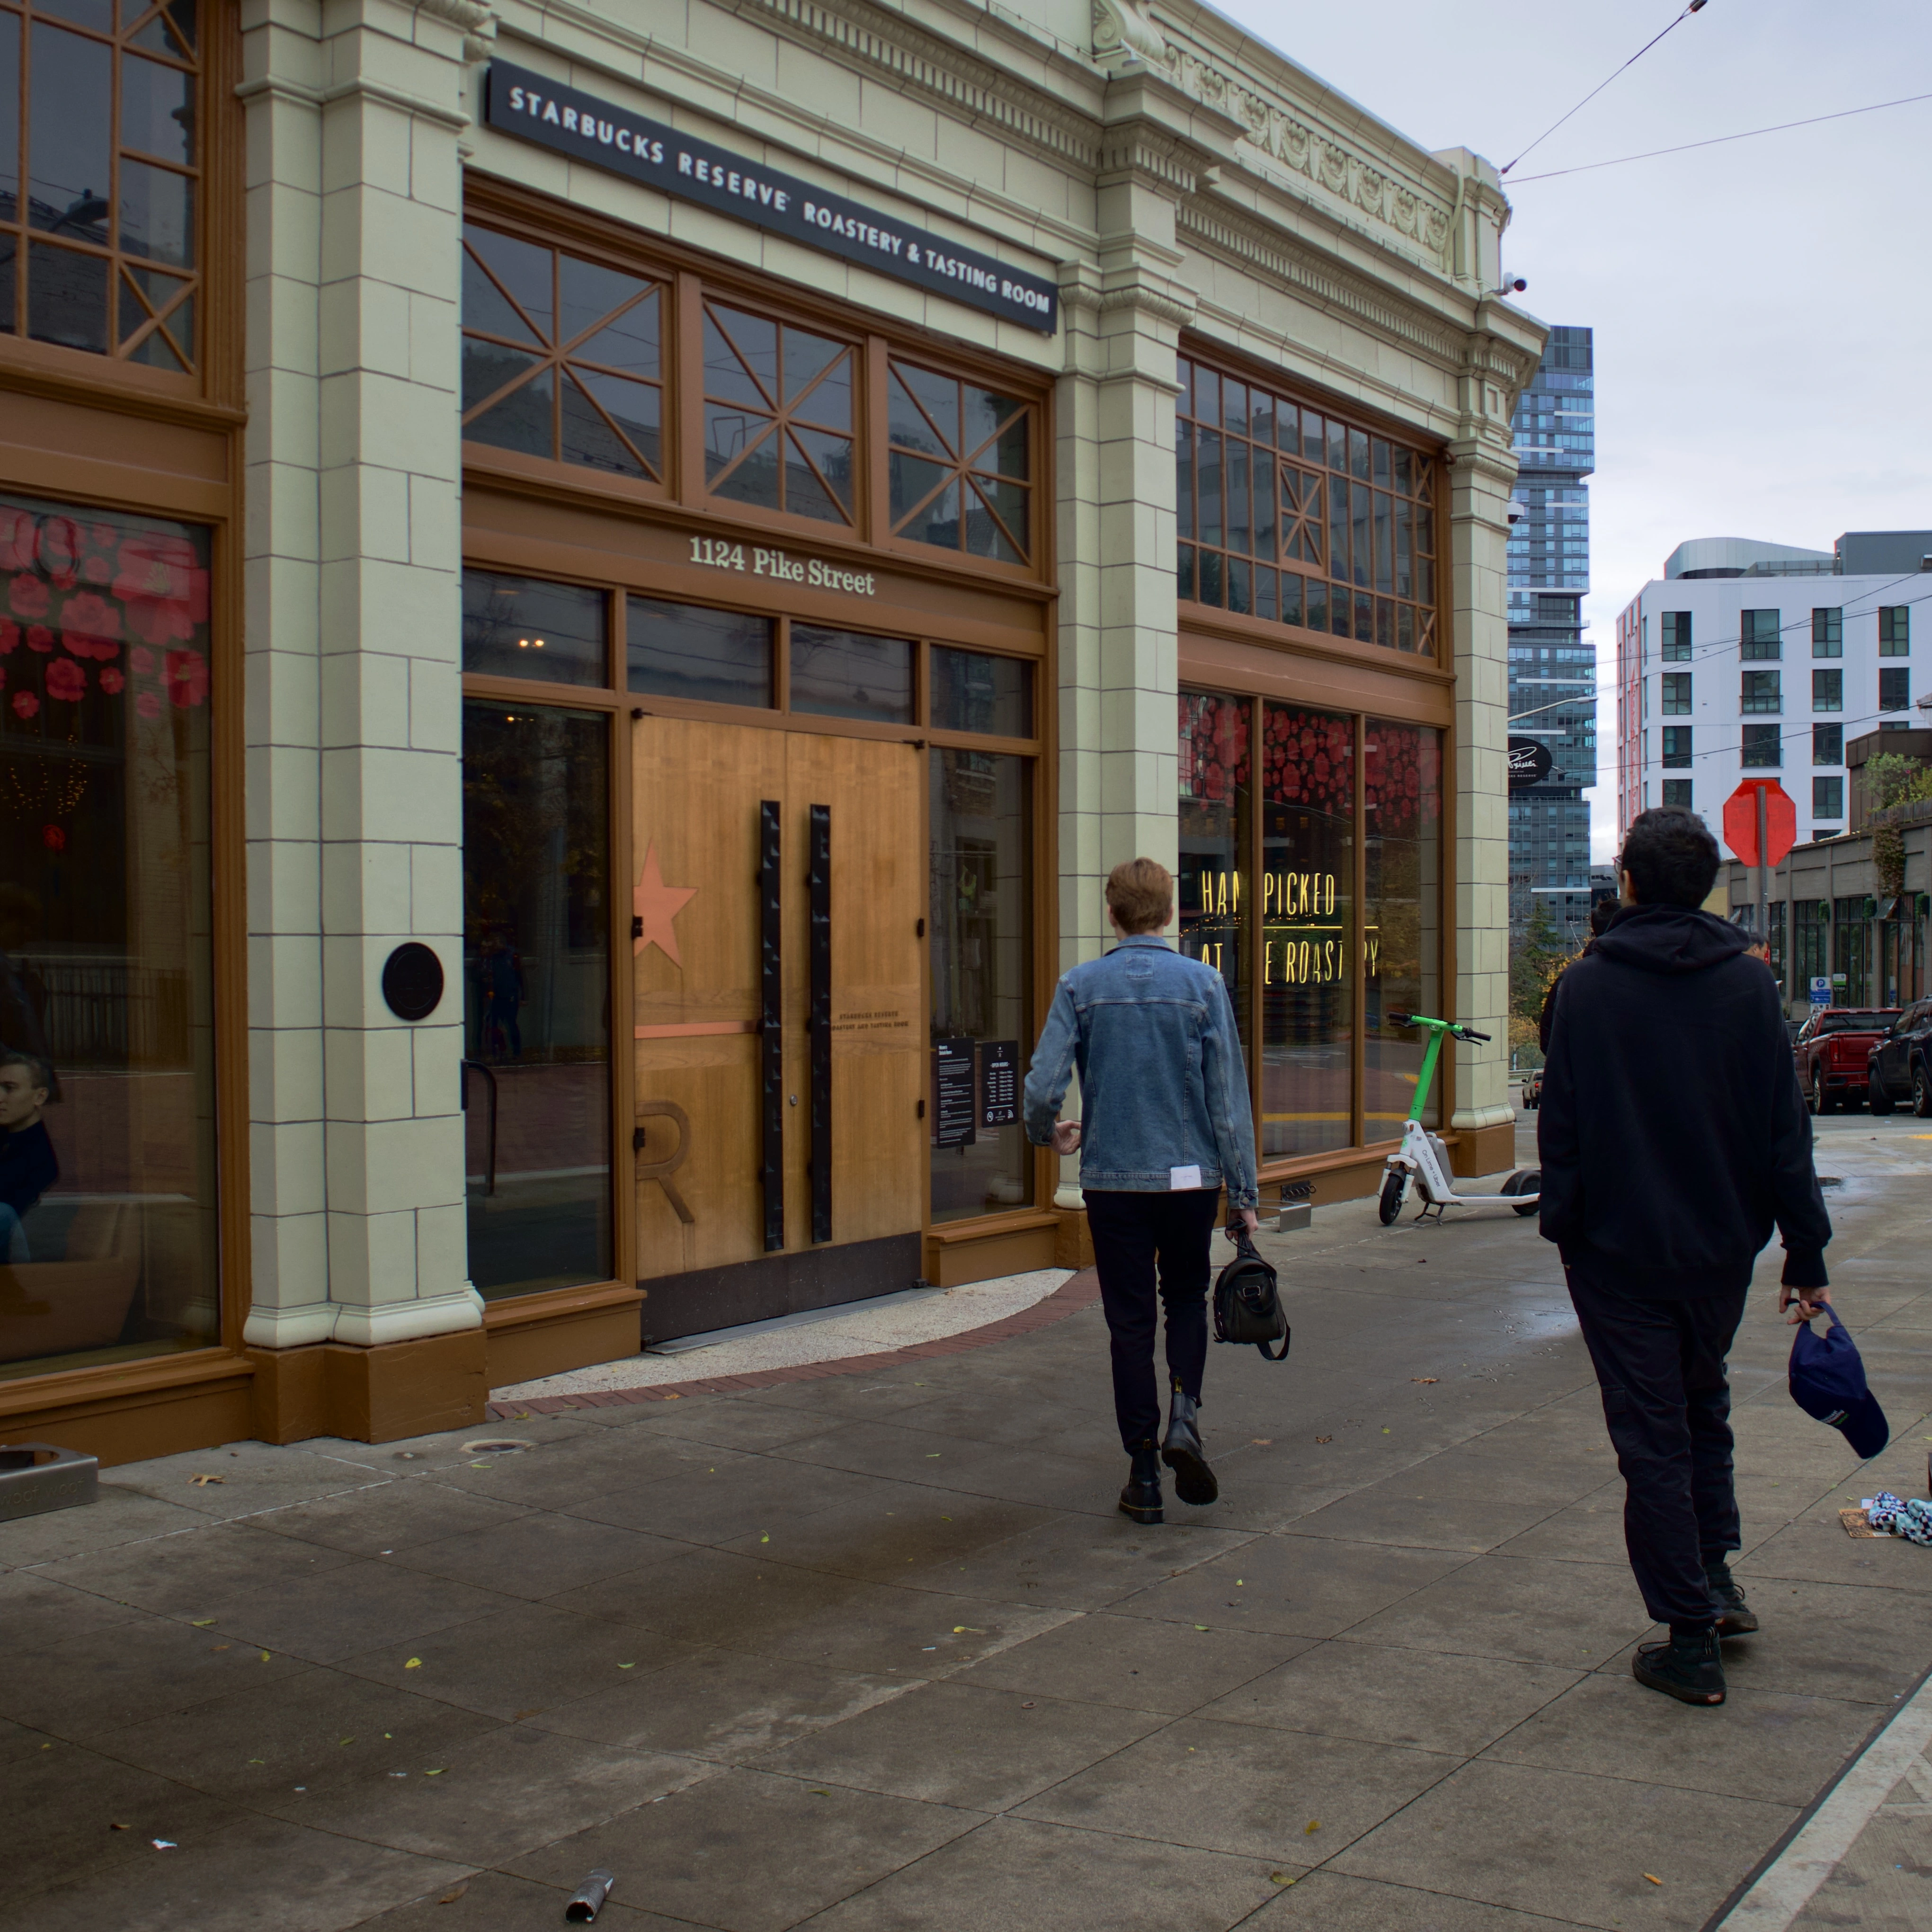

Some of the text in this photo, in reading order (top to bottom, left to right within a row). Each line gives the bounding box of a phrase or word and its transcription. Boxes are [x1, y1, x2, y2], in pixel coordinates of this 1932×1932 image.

[509, 87, 664, 164] STARBUCKS
[804, 202, 902, 255] ROASTERY
[907, 243, 920, 264] &
[925, 249, 997, 293] TASTING
[1002, 280, 1050, 313] ROOM
[689, 536, 875, 596] 1124 Pike Street
[1422, 1149, 1428, 1158] On
[45, 1477, 86, 1497] woof
